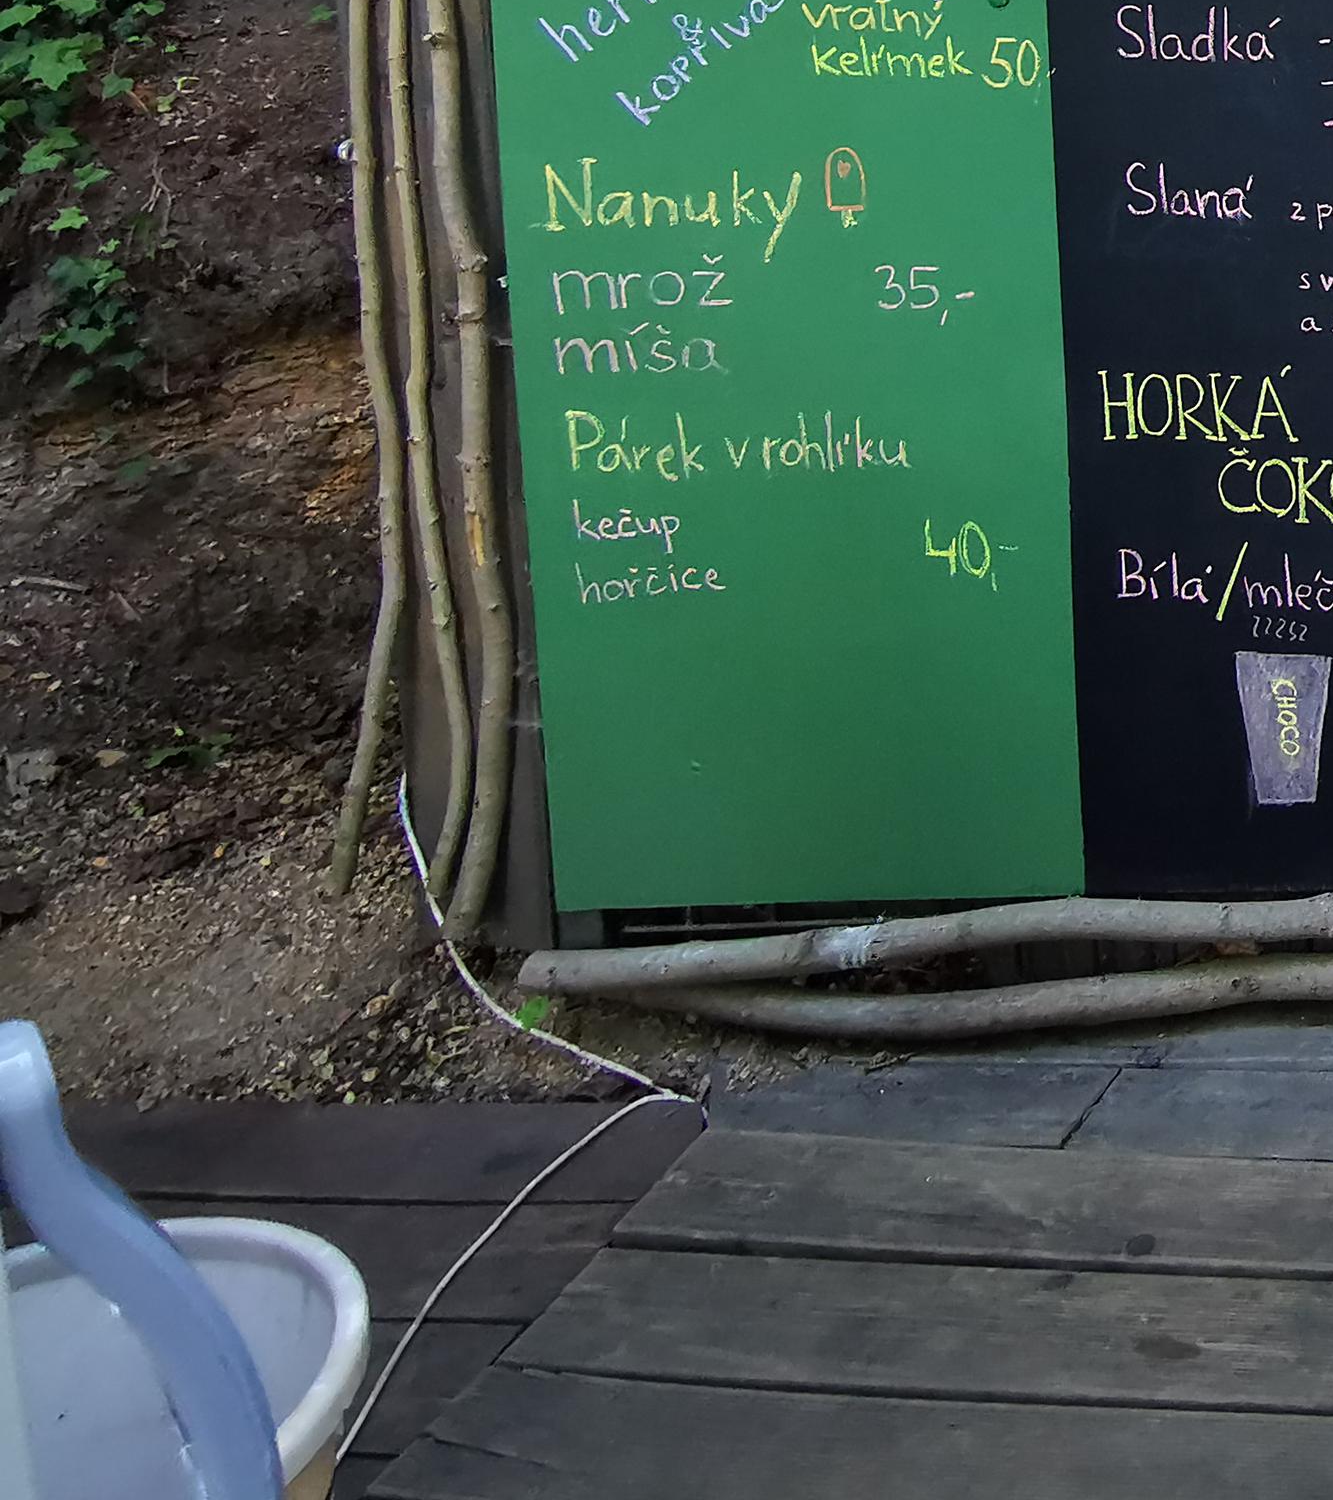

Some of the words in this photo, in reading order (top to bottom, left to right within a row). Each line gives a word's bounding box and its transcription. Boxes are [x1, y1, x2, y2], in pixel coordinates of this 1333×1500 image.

[1116, 4, 1281, 62] Sladká
[529, 157, 802, 263] Nanuky
[1125, 162, 1254, 221] Slaná
[551, 252, 733, 315] mrož
[1299, 271, 1310, 291] s
[554, 323, 728, 375] míša
[1300, 316, 1322, 333] a
[1098, 364, 1299, 443] HORKÁ
[564, 409, 705, 482] Párek
[725, 438, 750, 469] v
[763, 410, 911, 473] rohlíku
[573, 499, 681, 553] kečup
[1271, 678, 1300, 757] CHOCO
